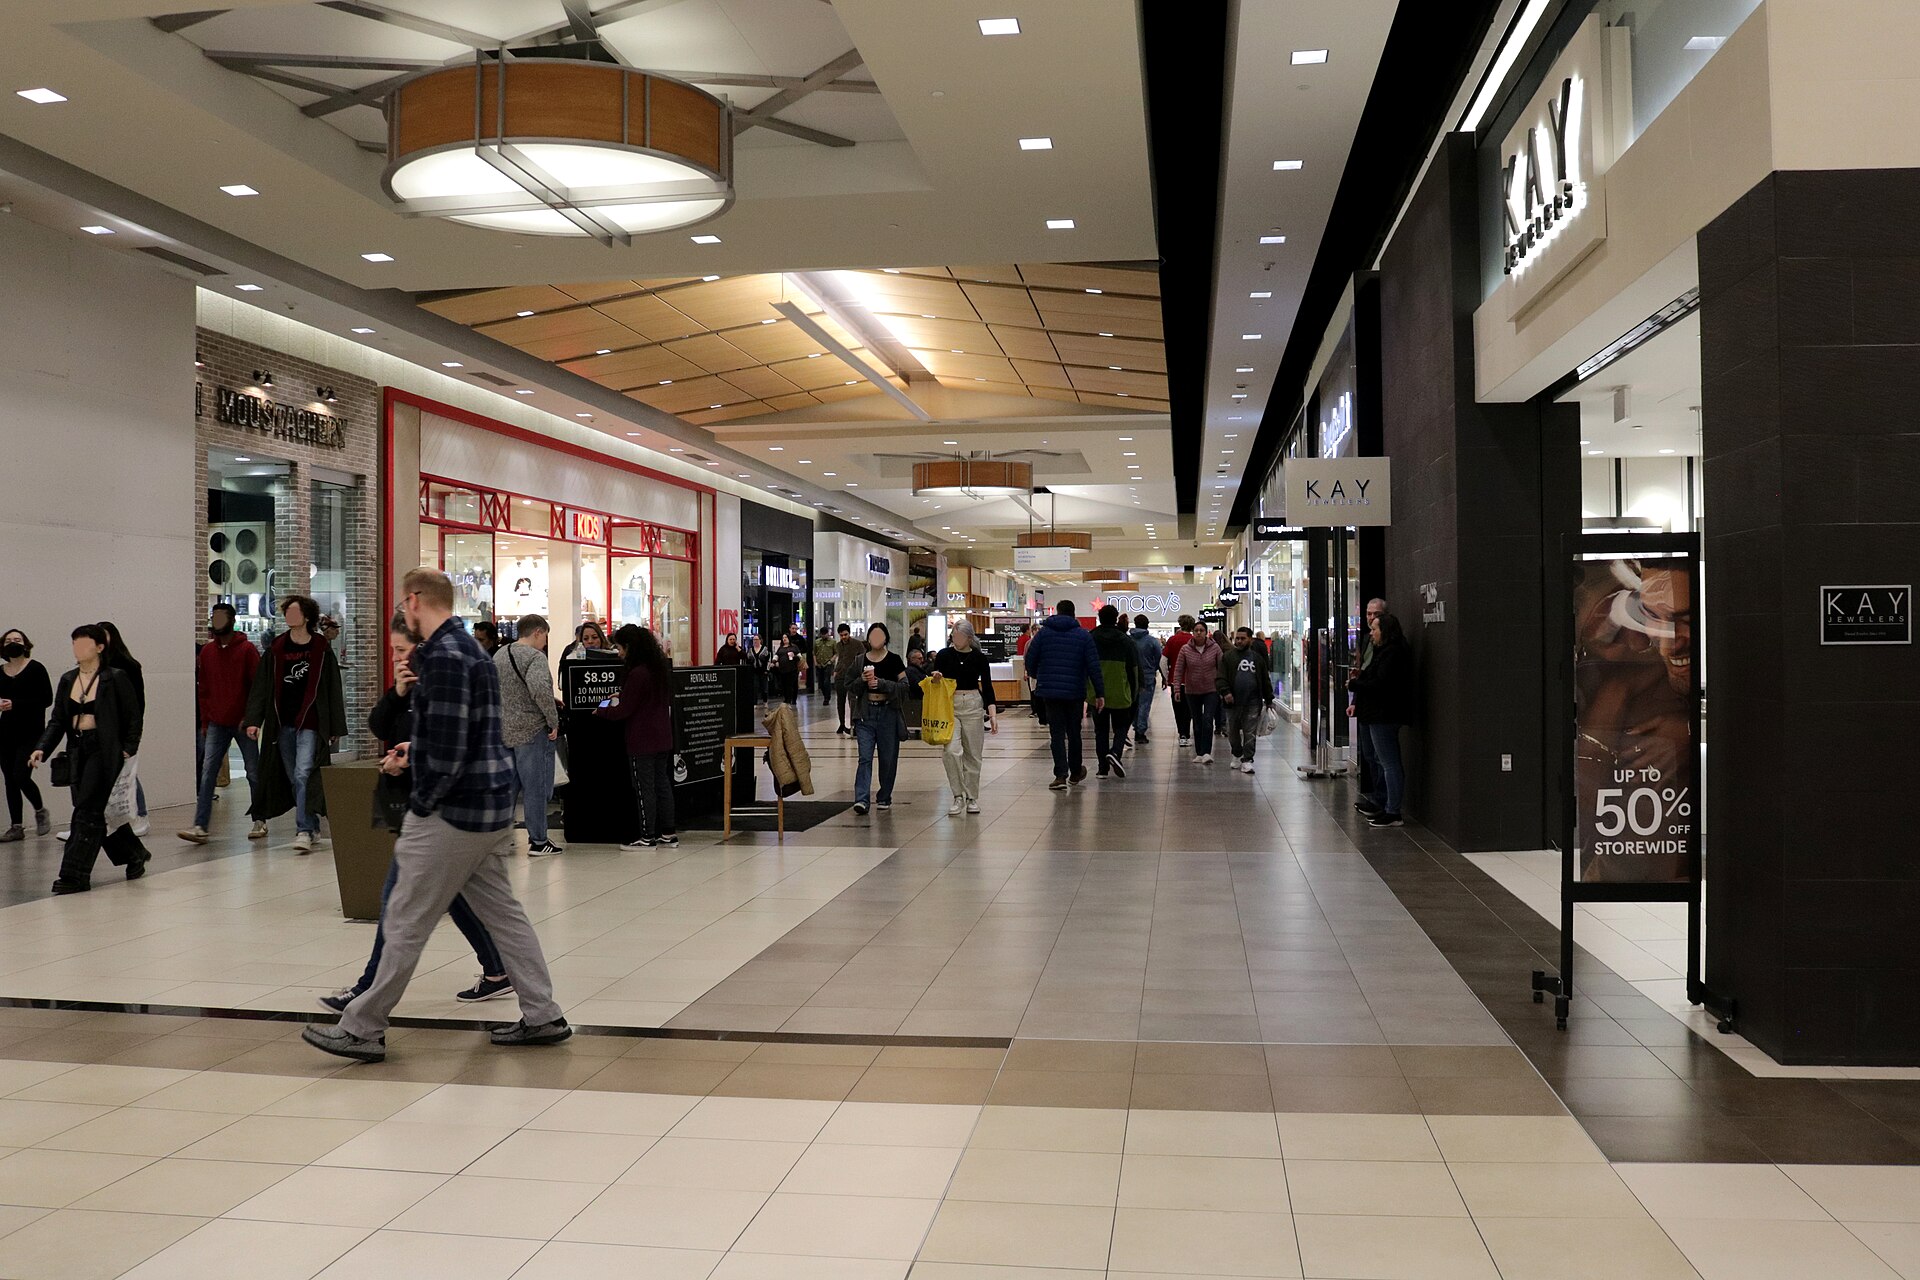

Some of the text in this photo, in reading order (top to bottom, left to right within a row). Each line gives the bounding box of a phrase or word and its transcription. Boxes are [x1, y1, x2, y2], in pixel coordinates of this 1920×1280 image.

[1503, 77, 1576, 247] KAY
[1306, 479, 1370, 499] KAY
[577, 513, 600, 541] KIDS
[1107, 590, 1181, 616] macy's
[1827, 591, 1905, 615] KAY
[719, 608, 739, 636] KIDS
[1827, 615, 1905, 623] JEWELERS
[584, 670, 616, 684] $8.99
[574, 695, 587, 704] (10
[578, 686, 587, 695] 10
[1613, 767, 1661, 783] UP TO
[1595, 786, 1691, 837] 50%
[1668, 824, 1691, 835] OFF
[1594, 840, 1687, 855] STOREWIDE
